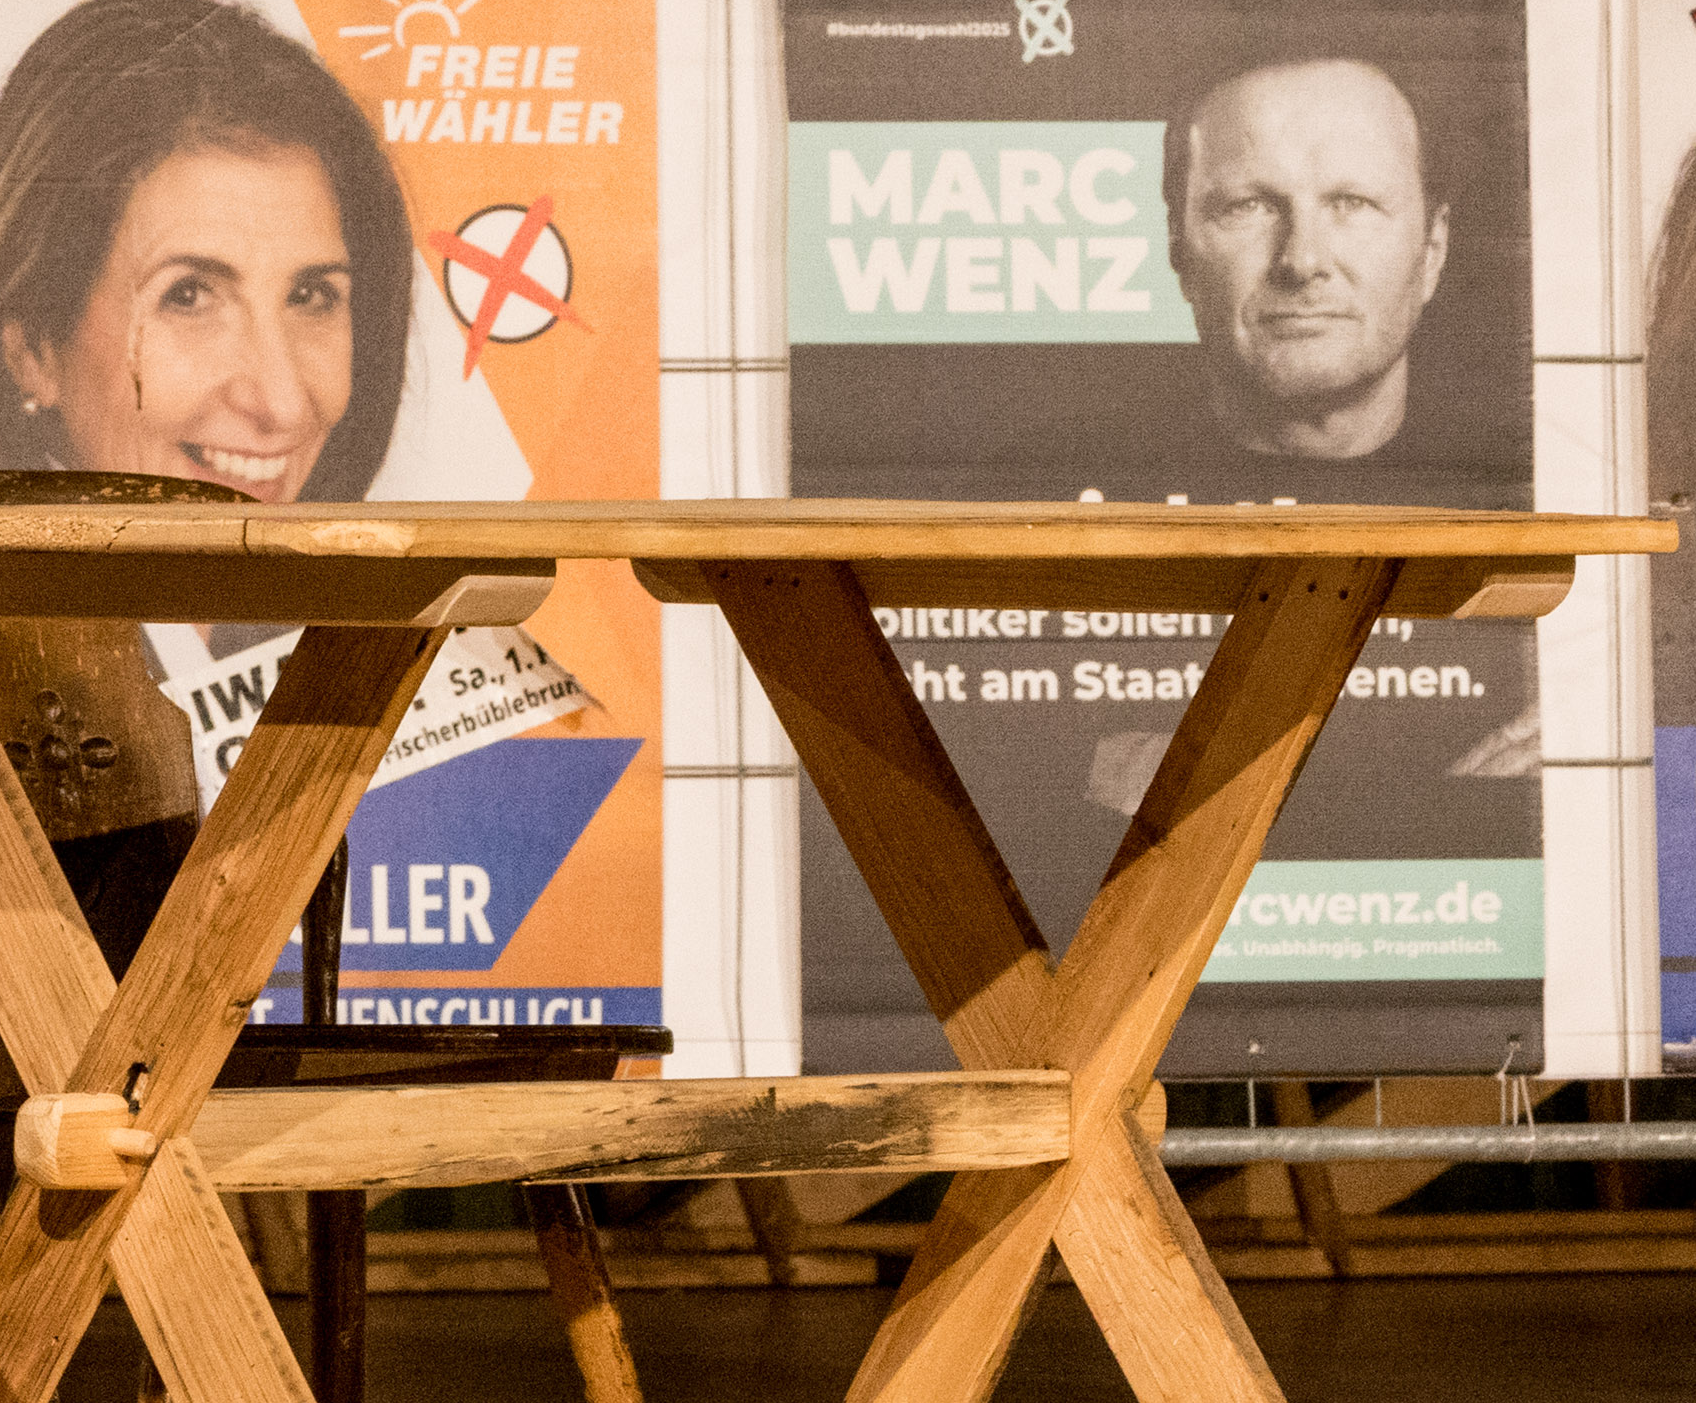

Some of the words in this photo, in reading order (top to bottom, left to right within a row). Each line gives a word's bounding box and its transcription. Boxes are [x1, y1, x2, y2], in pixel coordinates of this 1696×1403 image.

[405, 45, 581, 89] FREIE
[382, 90, 625, 145] WÄHLER
[826, 147, 1139, 226] MARC
[825, 236, 1153, 315] WENZ
[873, 607, 1050, 639] olitiker
[980, 670, 1060, 702] am
[1229, 880, 1504, 926] rcwenz.de
